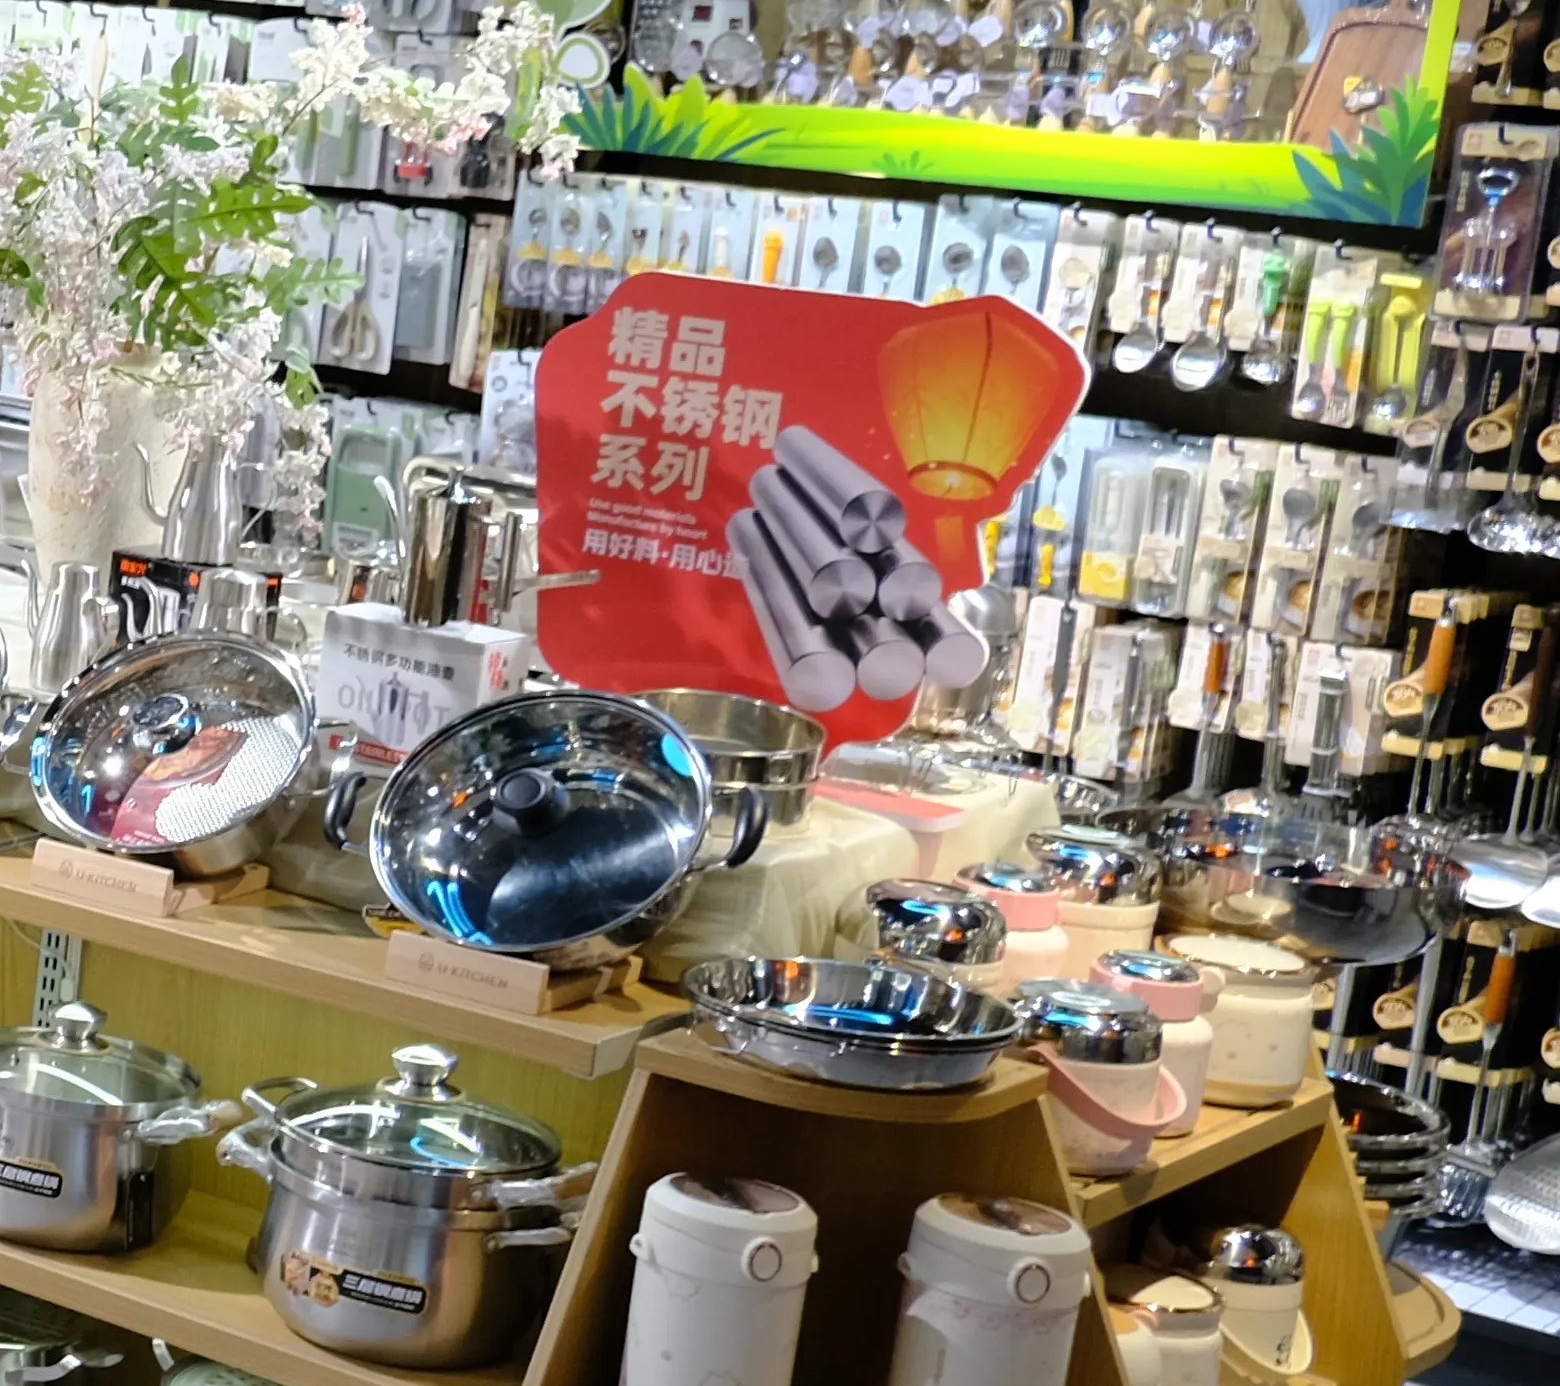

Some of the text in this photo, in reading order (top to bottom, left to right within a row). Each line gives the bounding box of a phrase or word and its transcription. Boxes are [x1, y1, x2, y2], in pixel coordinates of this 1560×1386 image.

[606, 307, 726, 377] 精品
[600, 370, 783, 451] 不锈钢
[589, 433, 710, 502] 系列
[610, 501, 640, 517] good
[675, 525, 709, 540] heart
[342, 643, 456, 683] 不锈钢多功能油壶
[87, 872, 138, 893] KITCHEN
[450, 966, 509, 990] KITCHEN
